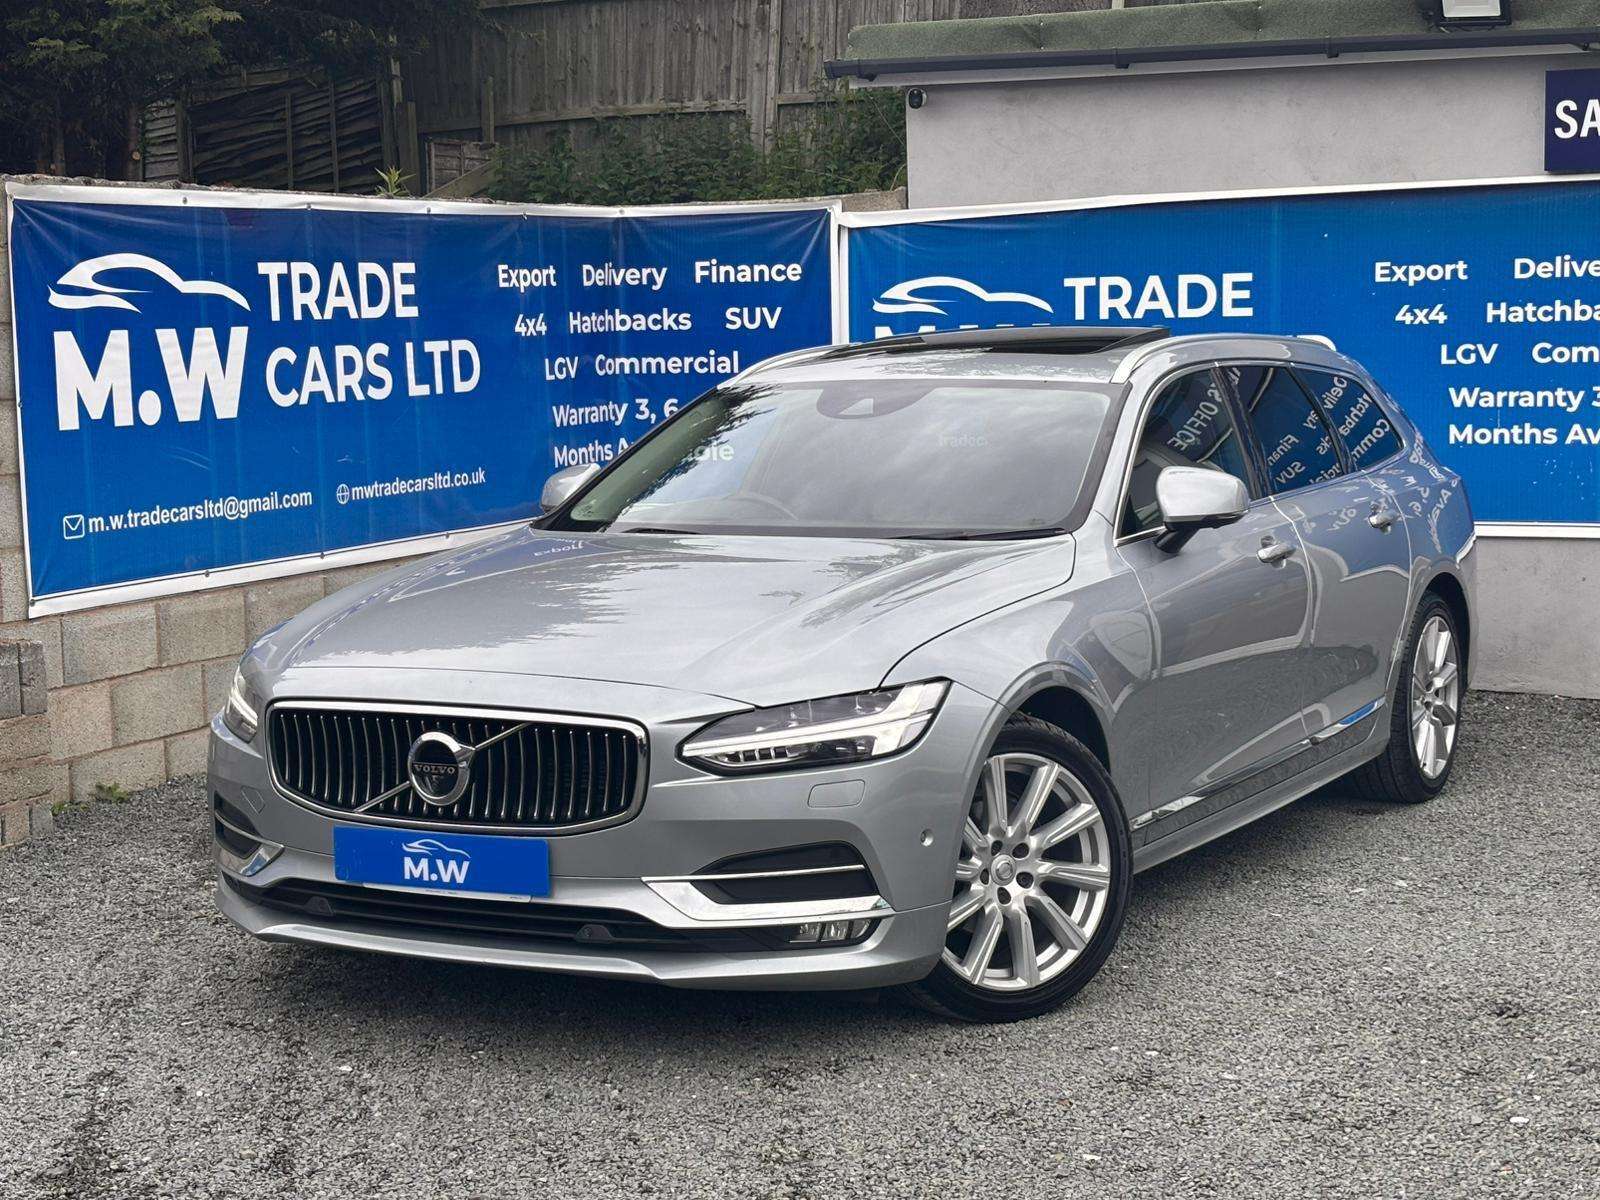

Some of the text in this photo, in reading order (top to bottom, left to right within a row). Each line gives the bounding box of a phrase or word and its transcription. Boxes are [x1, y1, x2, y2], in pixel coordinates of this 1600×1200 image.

[497, 258, 803, 293] Export Delivery Finance
[1374, 260, 1468, 287] Export
[258, 261, 419, 322] TRADE
[1063, 272, 1254, 321] TRADE
[514, 306, 783, 337] 4x4 Hatchbacks SUV
[1395, 303, 1448, 325] 4x4
[544, 350, 739, 381] LGV Commercial
[1440, 343, 1499, 365] LGV
[52, 325, 249, 431] M.W
[265, 339, 481, 408] CARS LTD
[552, 401, 629, 428] Warranty
[635, 398, 657, 424] 3,
[1448, 387, 1586, 413] Warranty
[1448, 422, 1558, 445] Months
[554, 440, 613, 468] Months
[351, 467, 486, 502] mwtradecarsltd.co.uk
[88, 490, 313, 533] m.w.tradecarsltd@gmail.com
[413, 764, 456, 775] VOLVO
[402, 856, 470, 884] M.W
